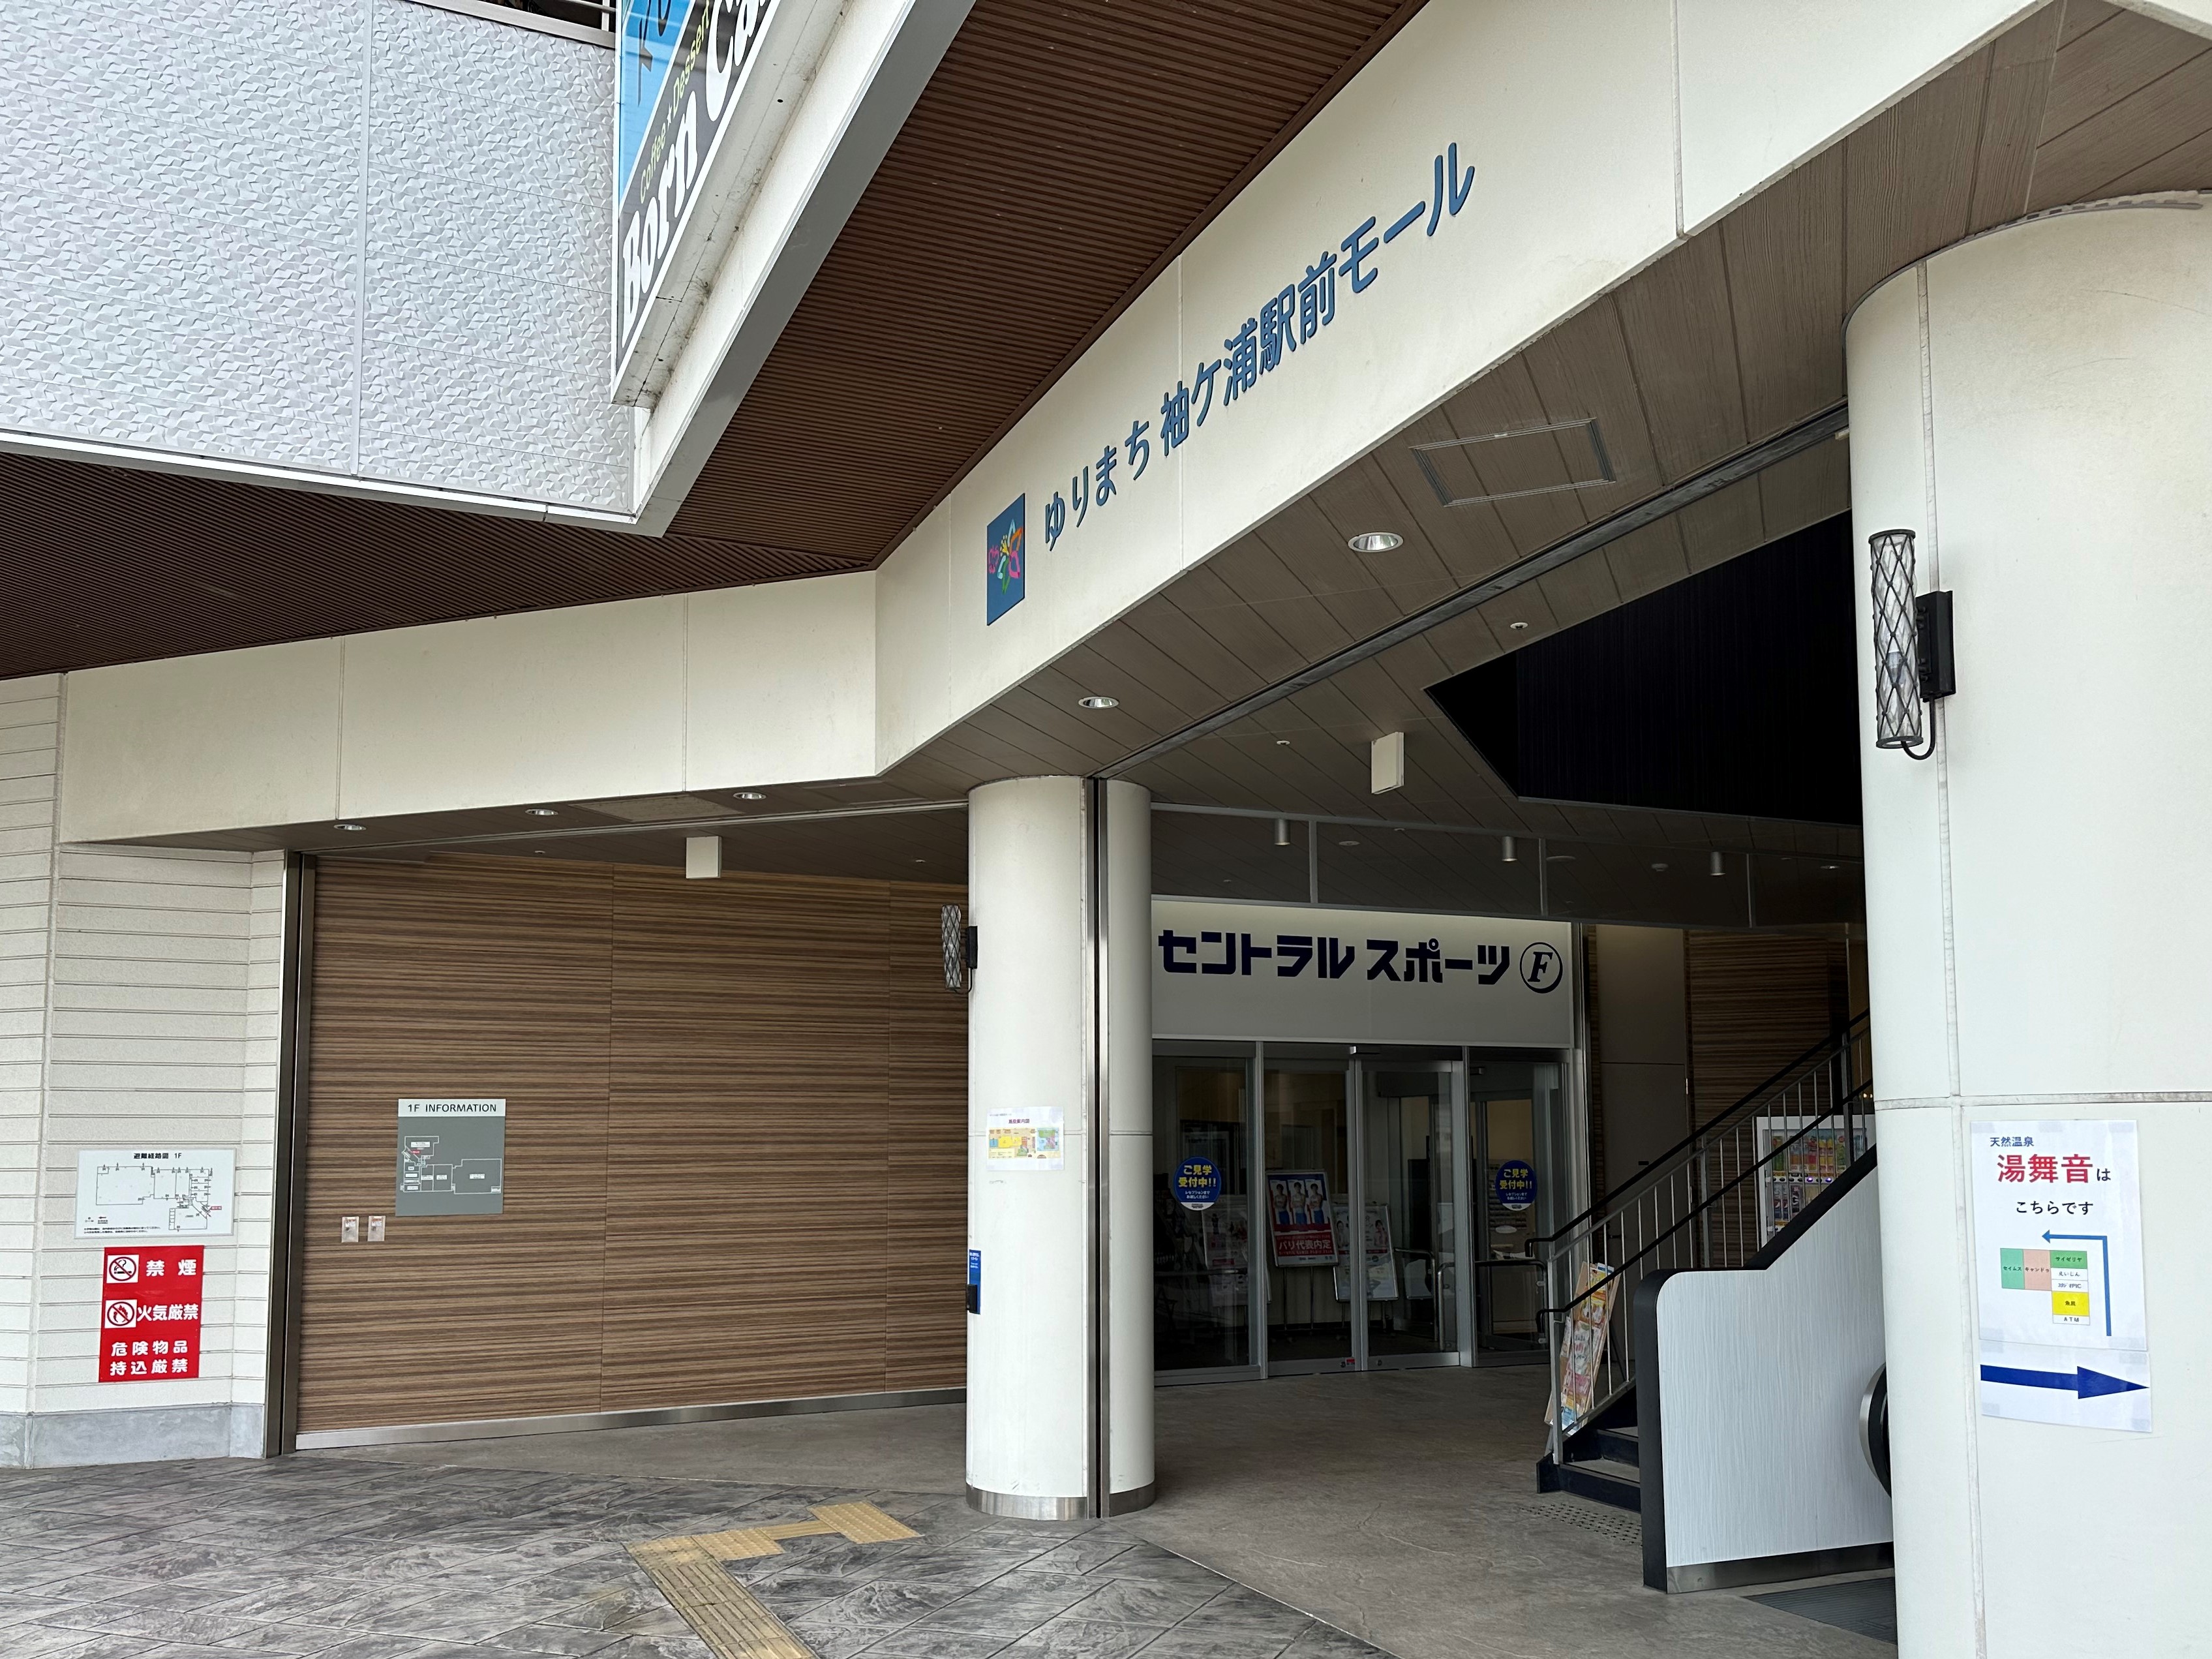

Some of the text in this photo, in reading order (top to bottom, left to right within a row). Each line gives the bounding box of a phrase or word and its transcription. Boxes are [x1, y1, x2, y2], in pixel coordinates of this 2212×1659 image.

[639, 122, 667, 204] Coffee
[622, 0, 770, 348] Born Ca
[408, 1104, 496, 1112] 1F INFORMATION
[1990, 1136, 2034, 1148] 天然温泉
[1183, 1164, 1212, 1175] ご見学
[1504, 1168, 1528, 1178] ご見学
[2016, 1200, 2094, 1215] こちらです
[145, 1259, 197, 1277] 禁煙
[136, 1303, 199, 1322] 火気厳禁
[111, 1340, 188, 1357] 危険物品
[110, 1358, 188, 1376] 持込厳禁
